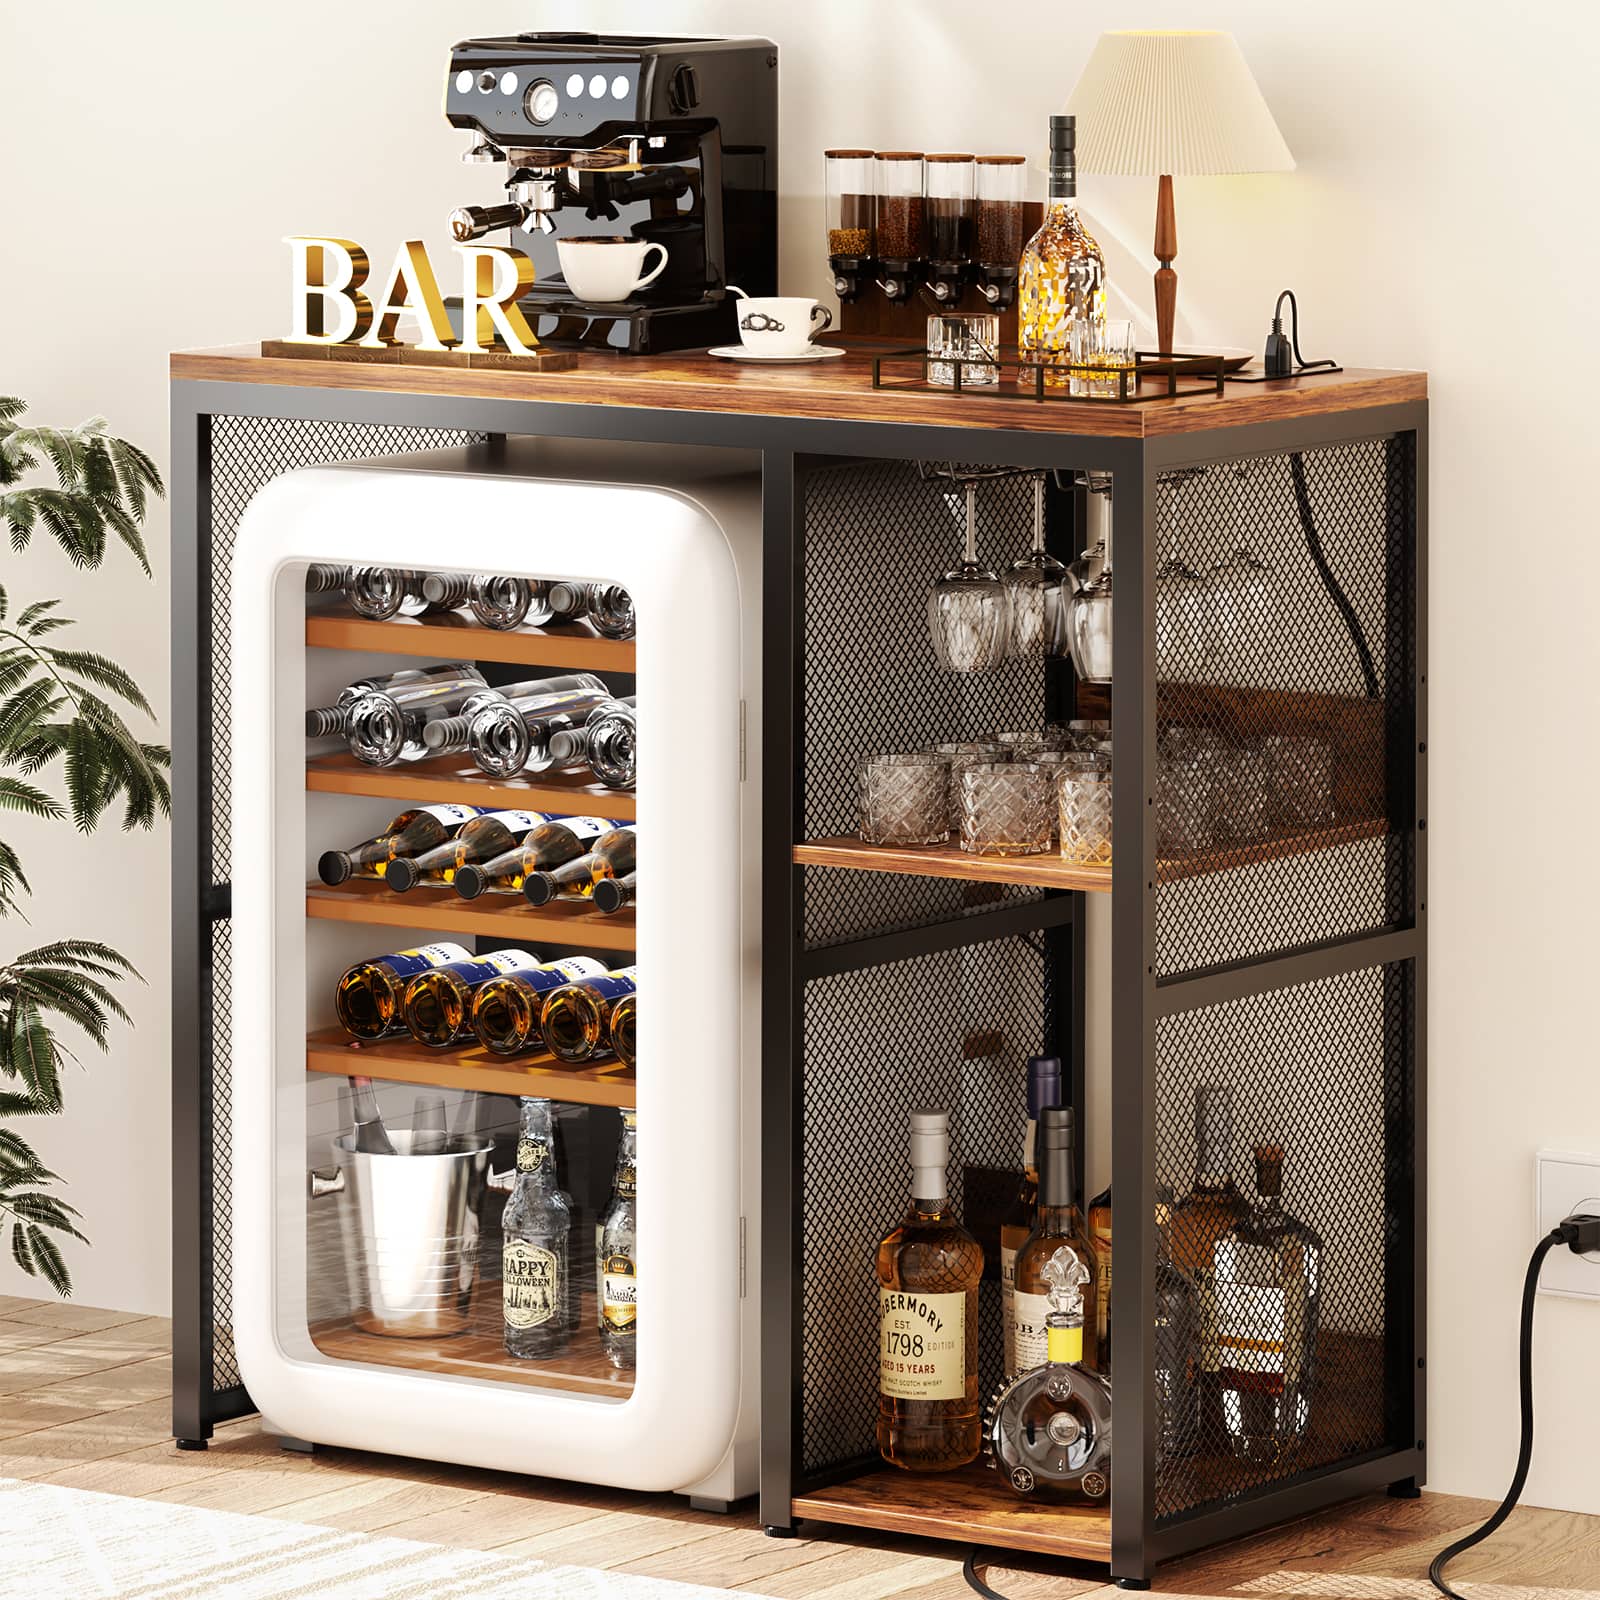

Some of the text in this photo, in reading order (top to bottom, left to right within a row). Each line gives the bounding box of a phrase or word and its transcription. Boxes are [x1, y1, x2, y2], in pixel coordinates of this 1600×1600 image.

[282, 235, 541, 356] BAR
[887, 1331, 924, 1358] 1798
[896, 1363, 904, 1374] 15
[906, 1364, 936, 1375] YEARS
